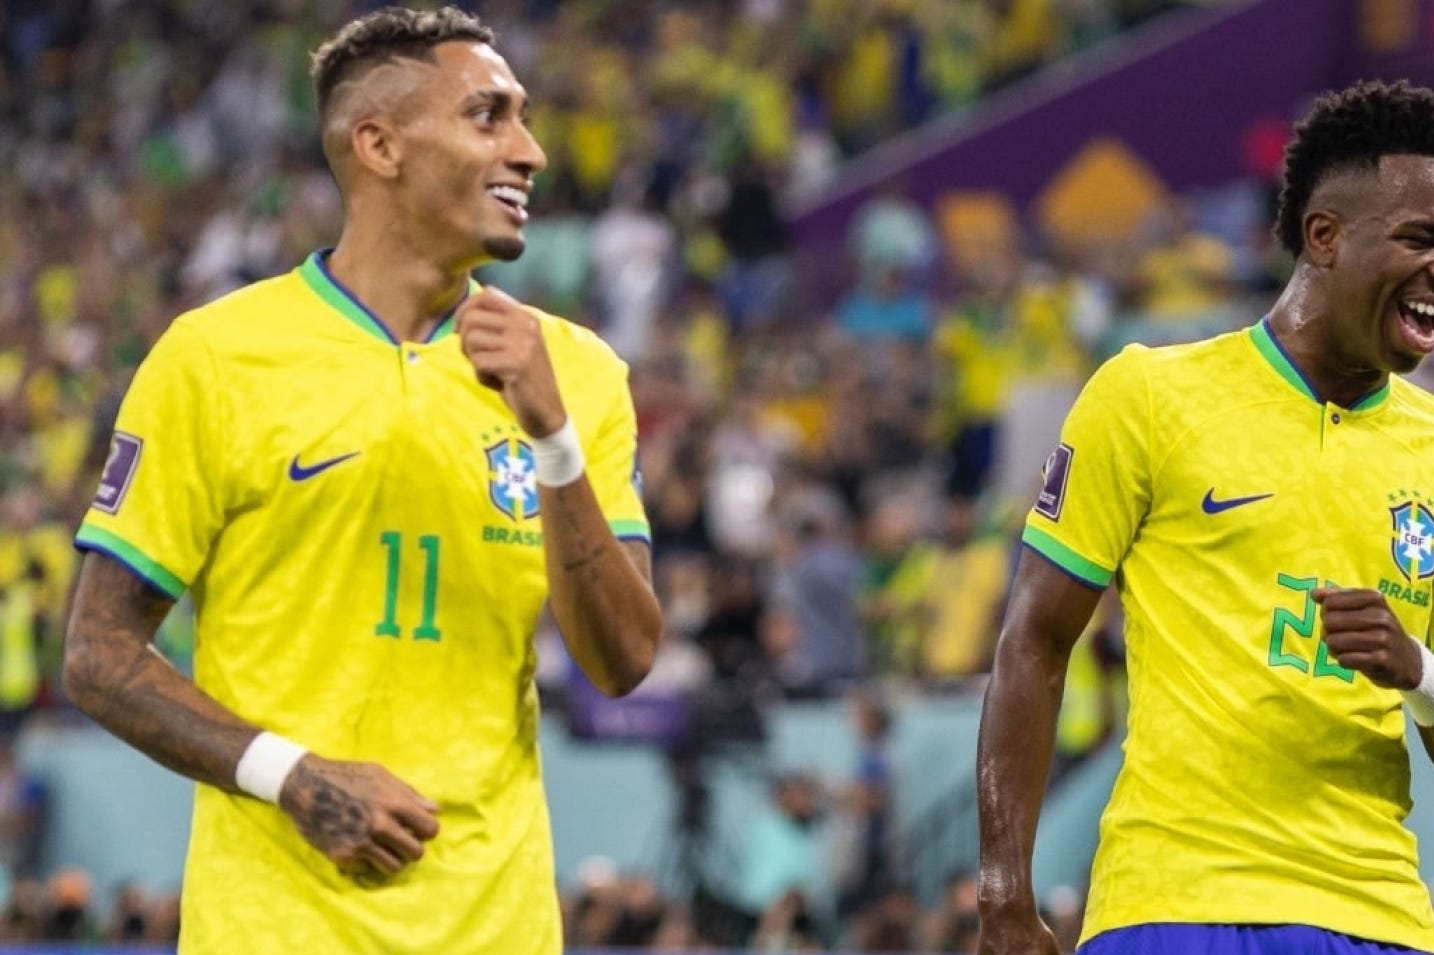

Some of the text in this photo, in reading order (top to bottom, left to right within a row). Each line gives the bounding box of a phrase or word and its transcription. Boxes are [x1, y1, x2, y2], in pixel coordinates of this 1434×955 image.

[482, 525, 542, 547] BRASI
[1404, 531, 1426, 548] CBF
[375, 531, 441, 642] 11
[1378, 578, 1430, 608] BRASIL
